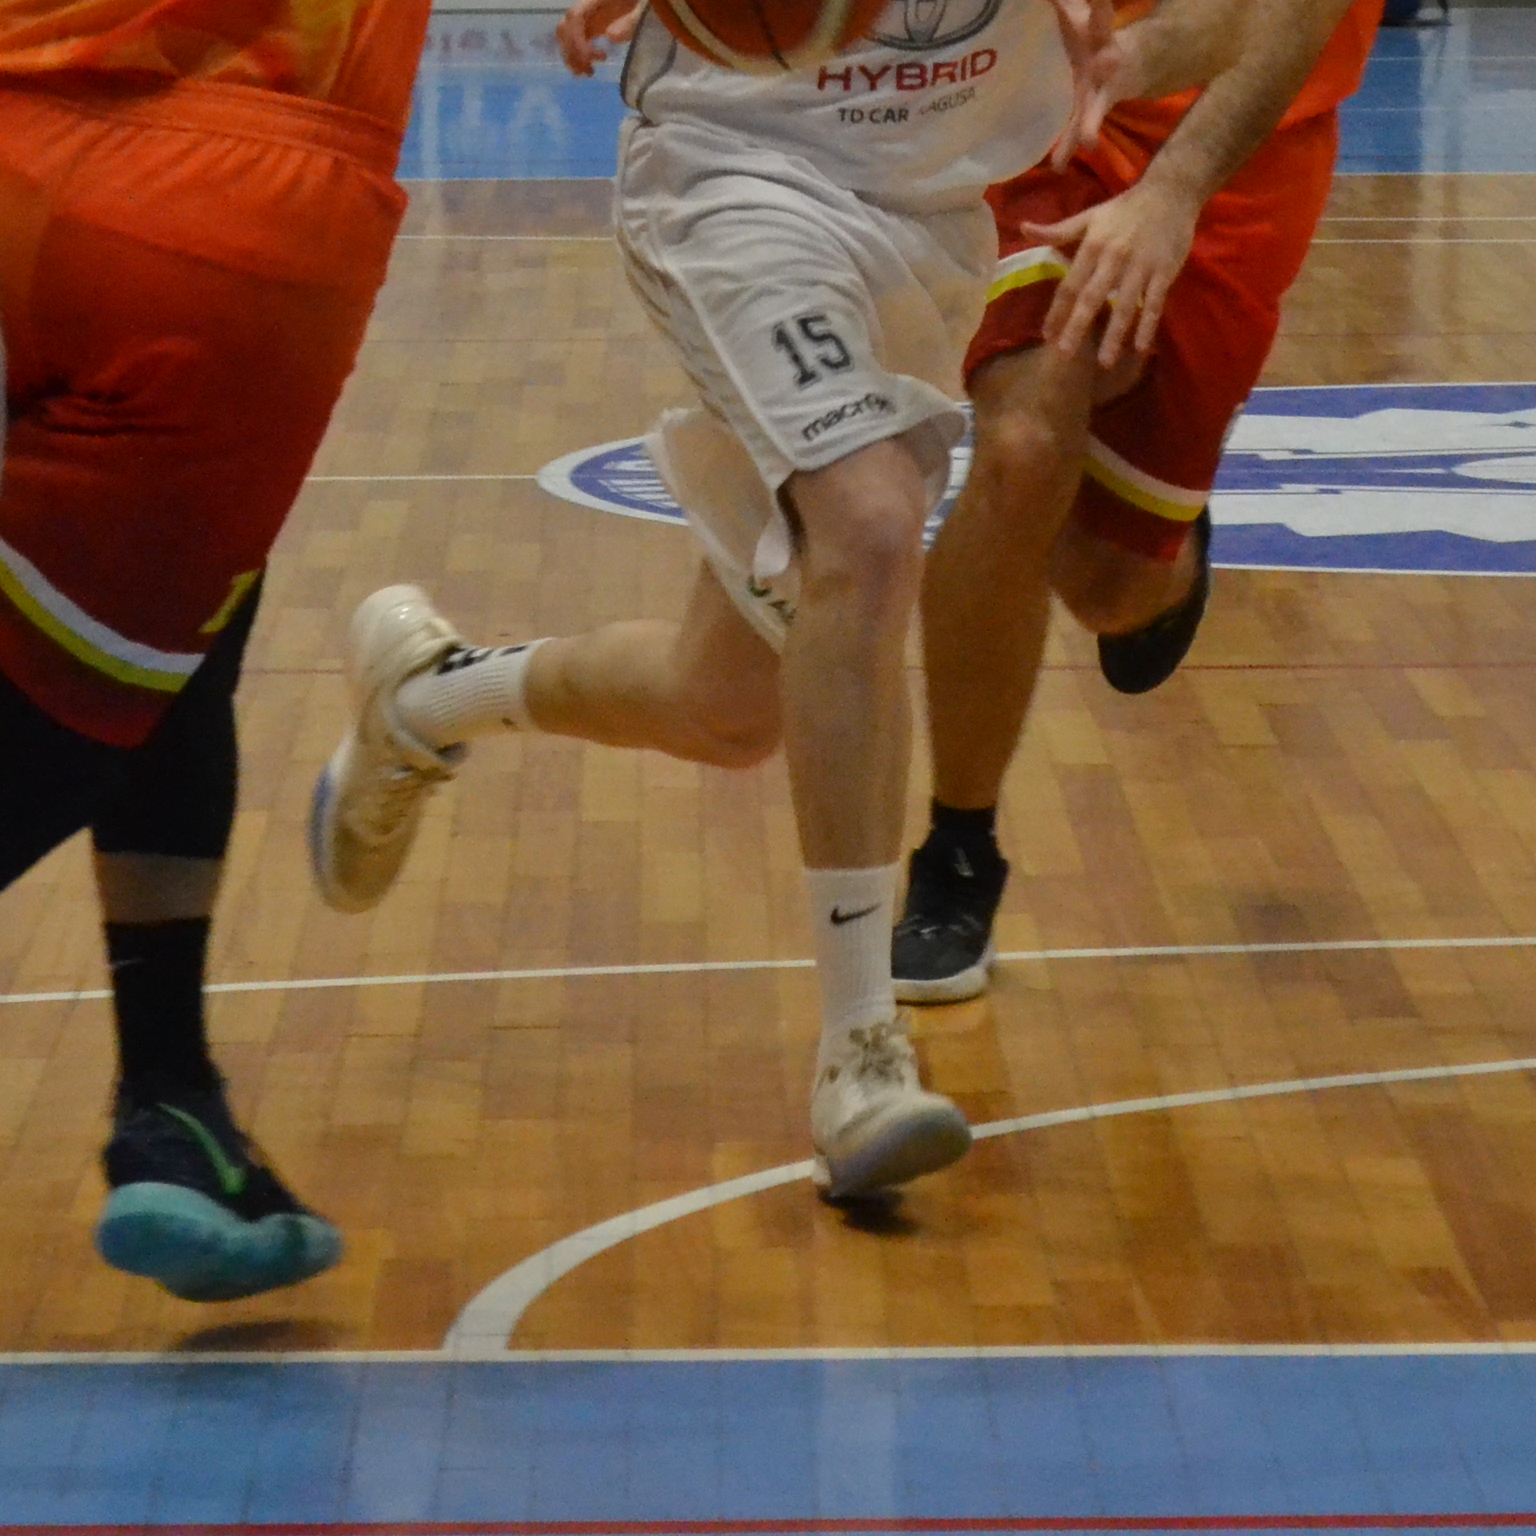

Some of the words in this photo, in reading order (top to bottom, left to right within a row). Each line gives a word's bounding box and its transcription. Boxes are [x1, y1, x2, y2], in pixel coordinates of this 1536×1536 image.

[817, 48, 999, 93] HYBRID
[868, 107, 910, 124] CAR
[770, 312, 854, 392] 15
